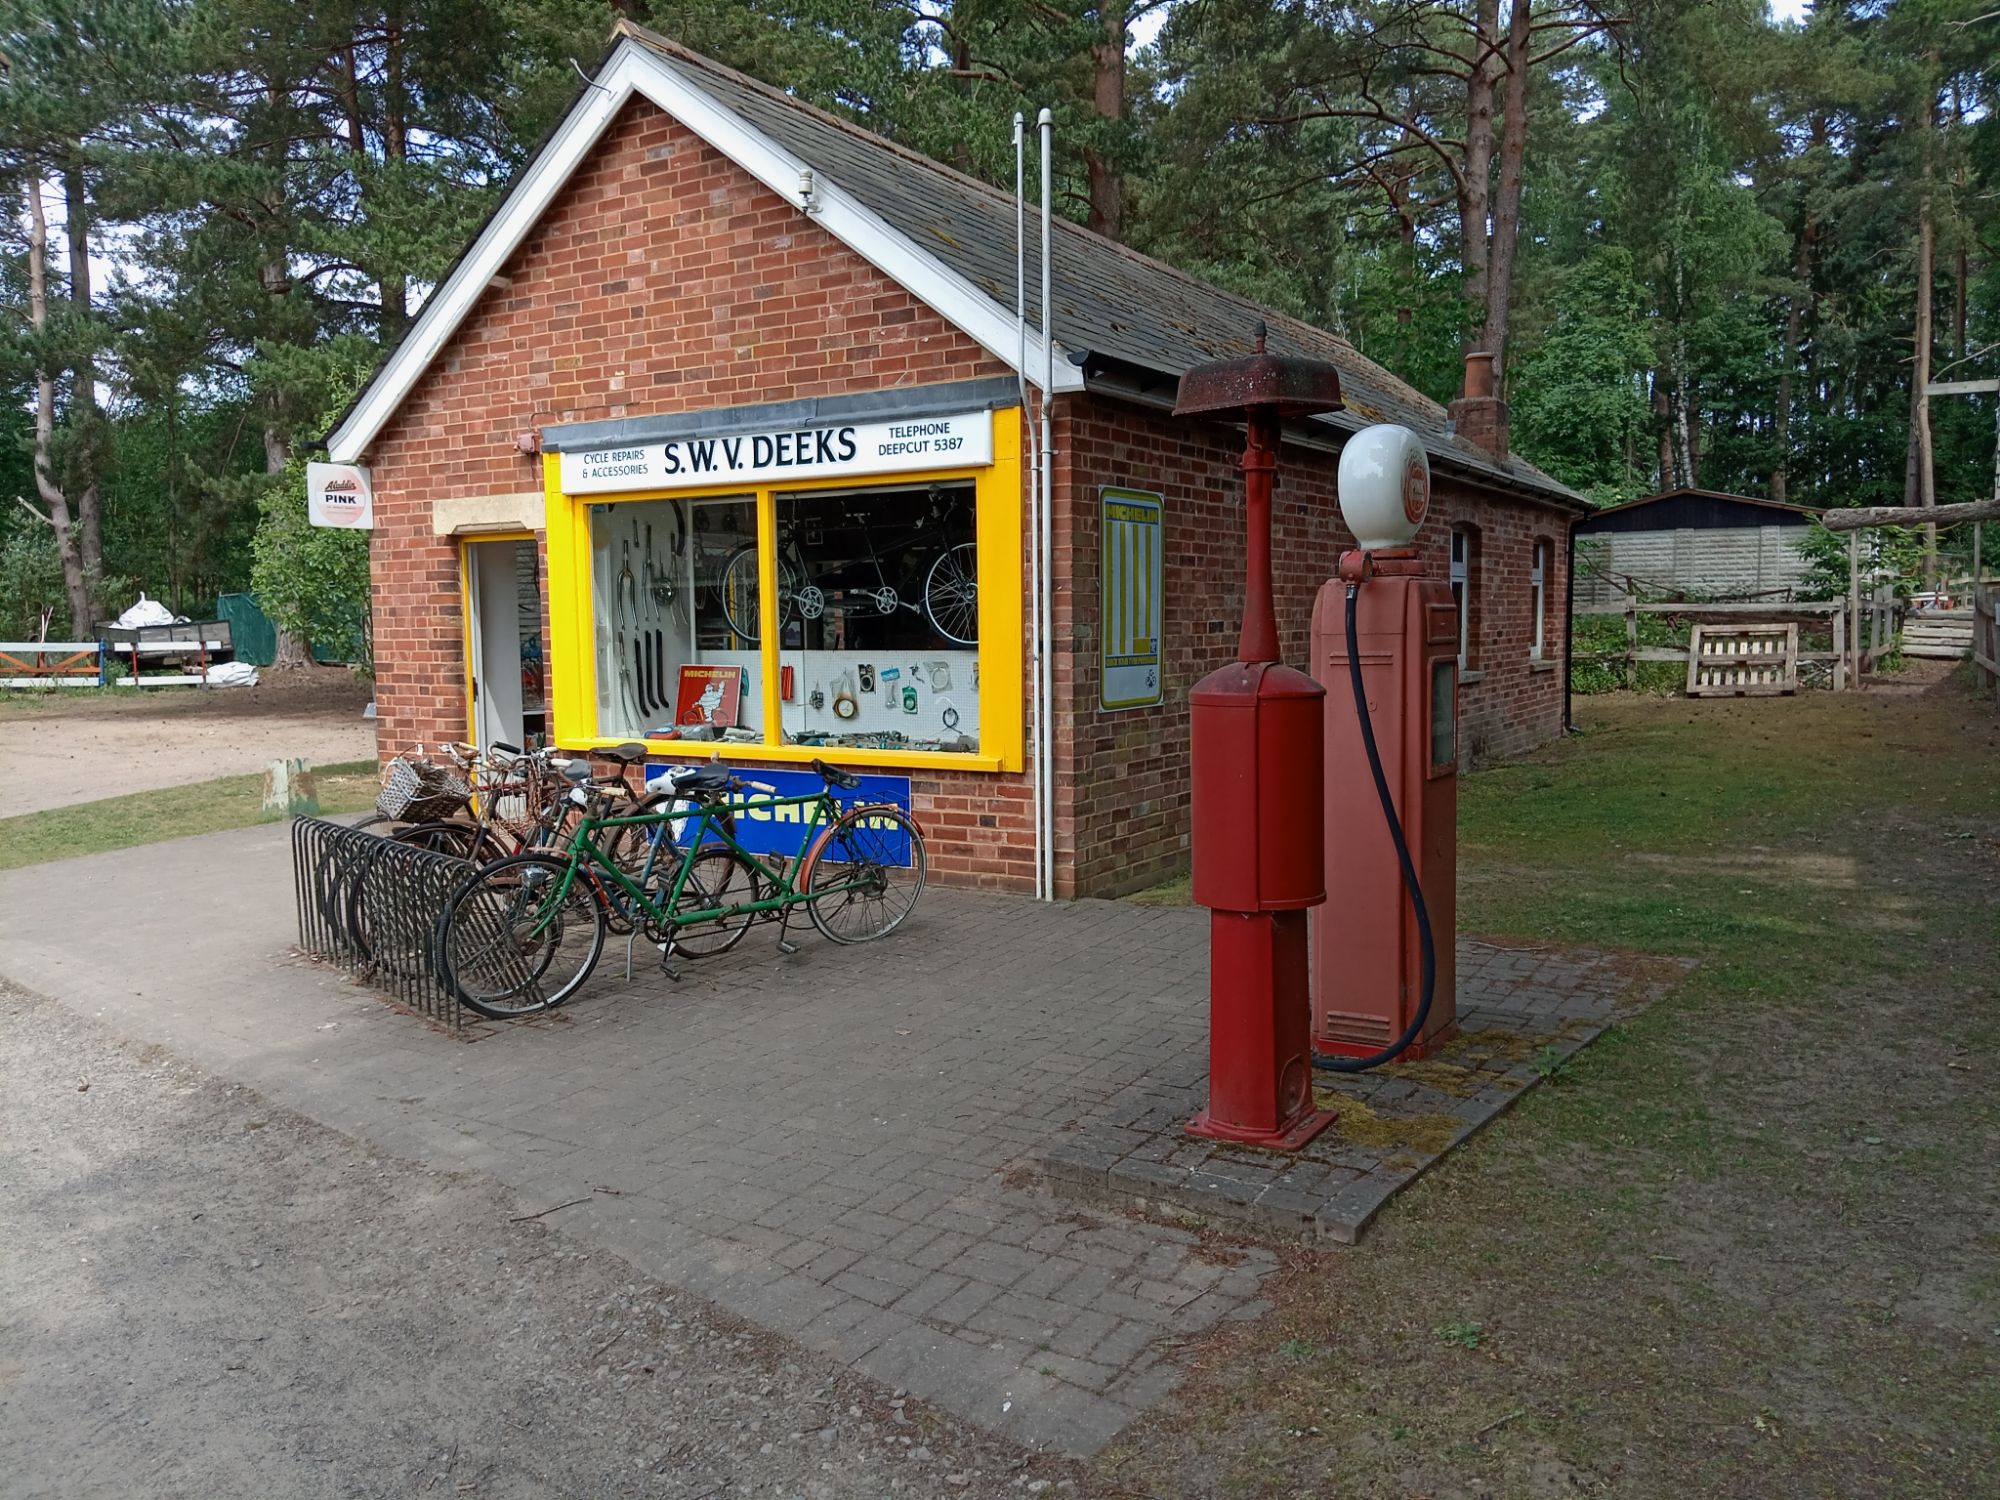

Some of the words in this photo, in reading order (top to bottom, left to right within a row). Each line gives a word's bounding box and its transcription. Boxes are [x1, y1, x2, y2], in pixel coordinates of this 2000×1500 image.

[889, 422, 950, 438] TELEPHONE
[752, 427, 856, 469] DEEKS
[878, 440, 930, 456] DEEPCUT
[934, 437, 963, 452] 5387
[584, 452, 609, 464] CYCLE
[612, 449, 645, 462] REPAIRS
[582, 468, 588, 479] &
[592, 463, 649, 478] ACCESSORIES
[325, 494, 357, 504] PINK
[684, 670, 736, 679] MICHELIN
